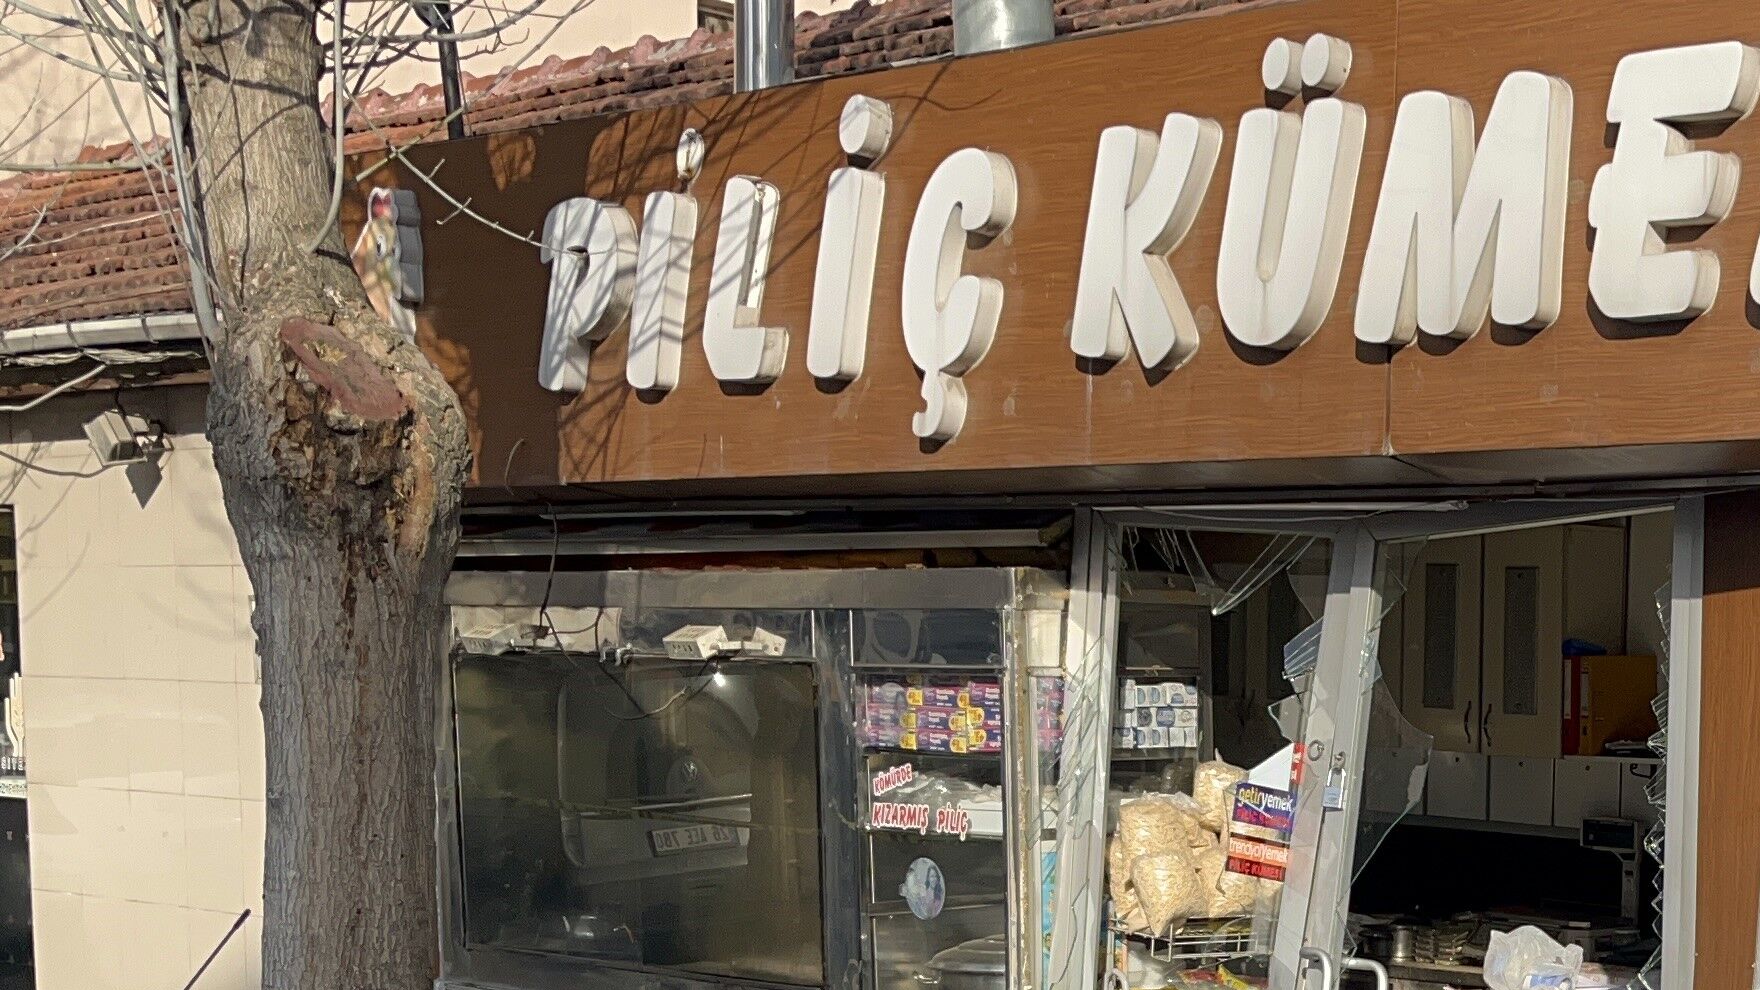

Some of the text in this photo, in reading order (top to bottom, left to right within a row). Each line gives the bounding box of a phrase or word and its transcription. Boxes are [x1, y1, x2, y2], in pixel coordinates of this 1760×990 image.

[538, 93, 1018, 443] PİLİÇ
[873, 763, 913, 796] KÖMÜRDE
[872, 802, 969, 841] KIZARMIŞ PİLİÇ
